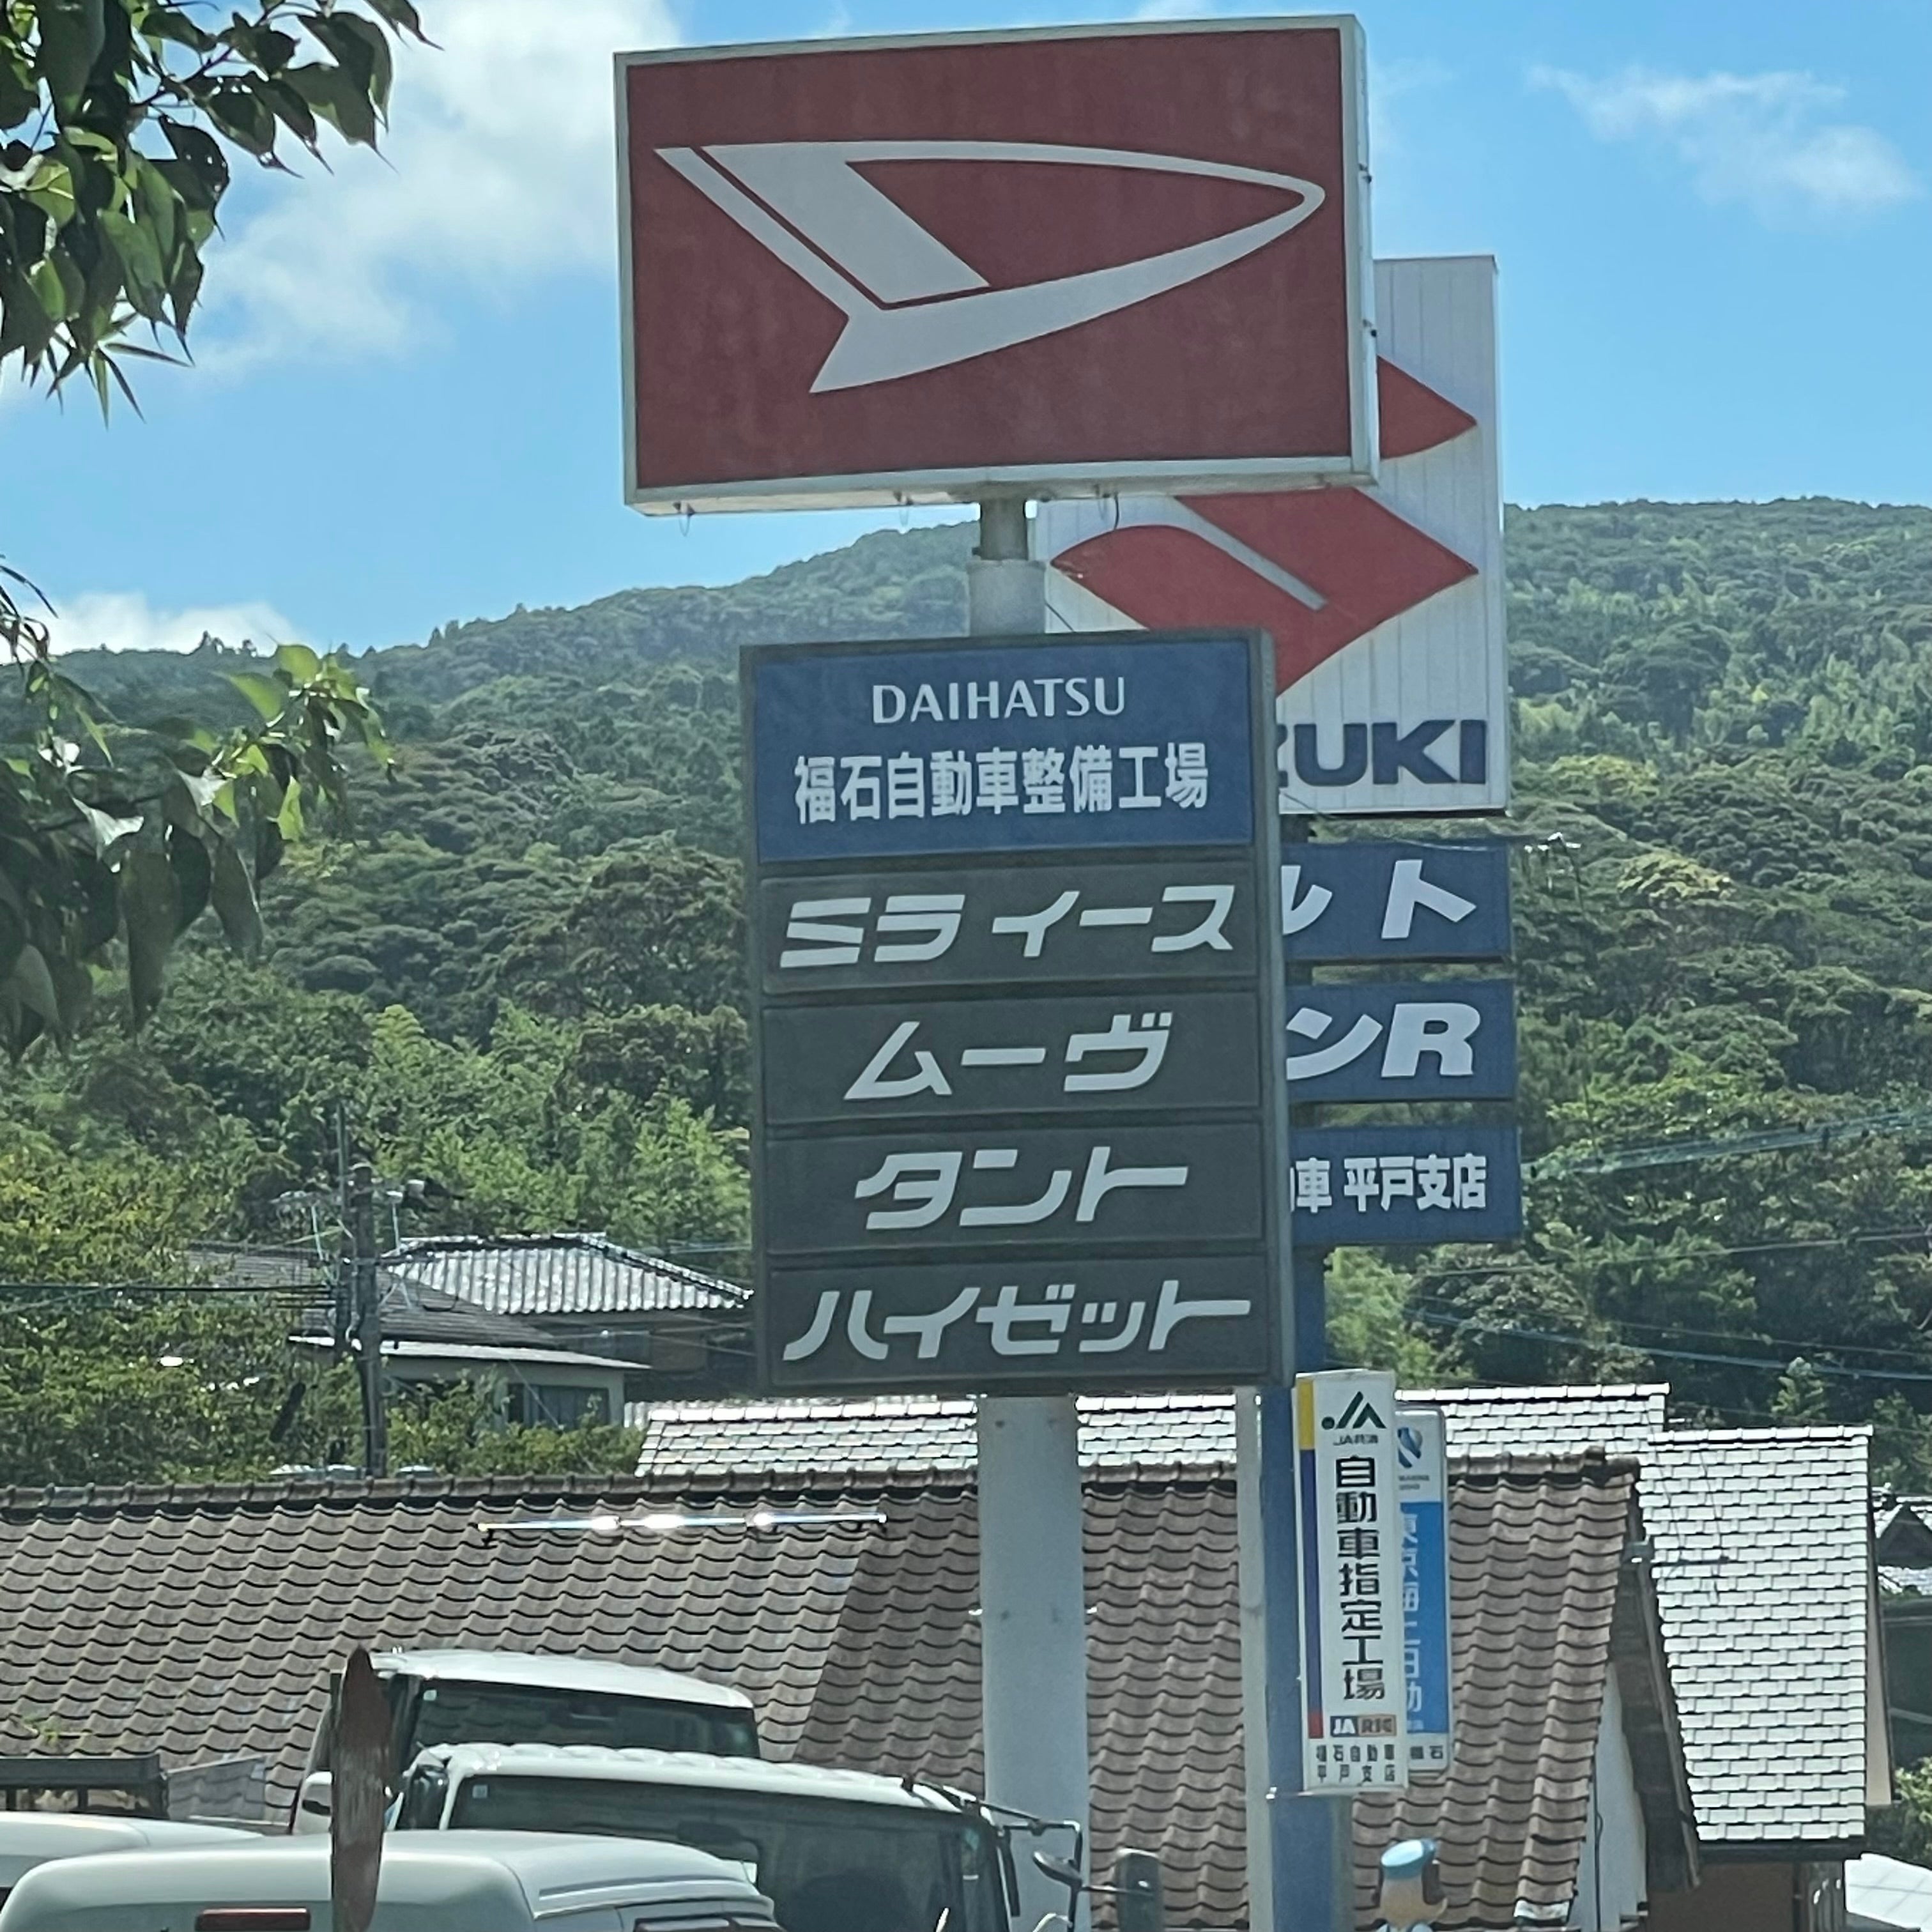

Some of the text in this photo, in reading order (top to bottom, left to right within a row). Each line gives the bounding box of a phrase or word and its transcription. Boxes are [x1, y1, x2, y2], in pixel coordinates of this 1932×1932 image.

[873, 677, 1124, 724] DAIHATSU
[794, 742, 1209, 825] 福石自動車整備工場
[1278, 719, 1487, 788] UKI
[843, 1012, 1173, 1100] ムーヴ
[854, 1146, 1188, 1230] タント
[1344, 1153, 1487, 1212] 平戸支店
[783, 1280, 1251, 1361] ハイゼット
[1335, 1455, 1385, 1700] 自動車指定工場
